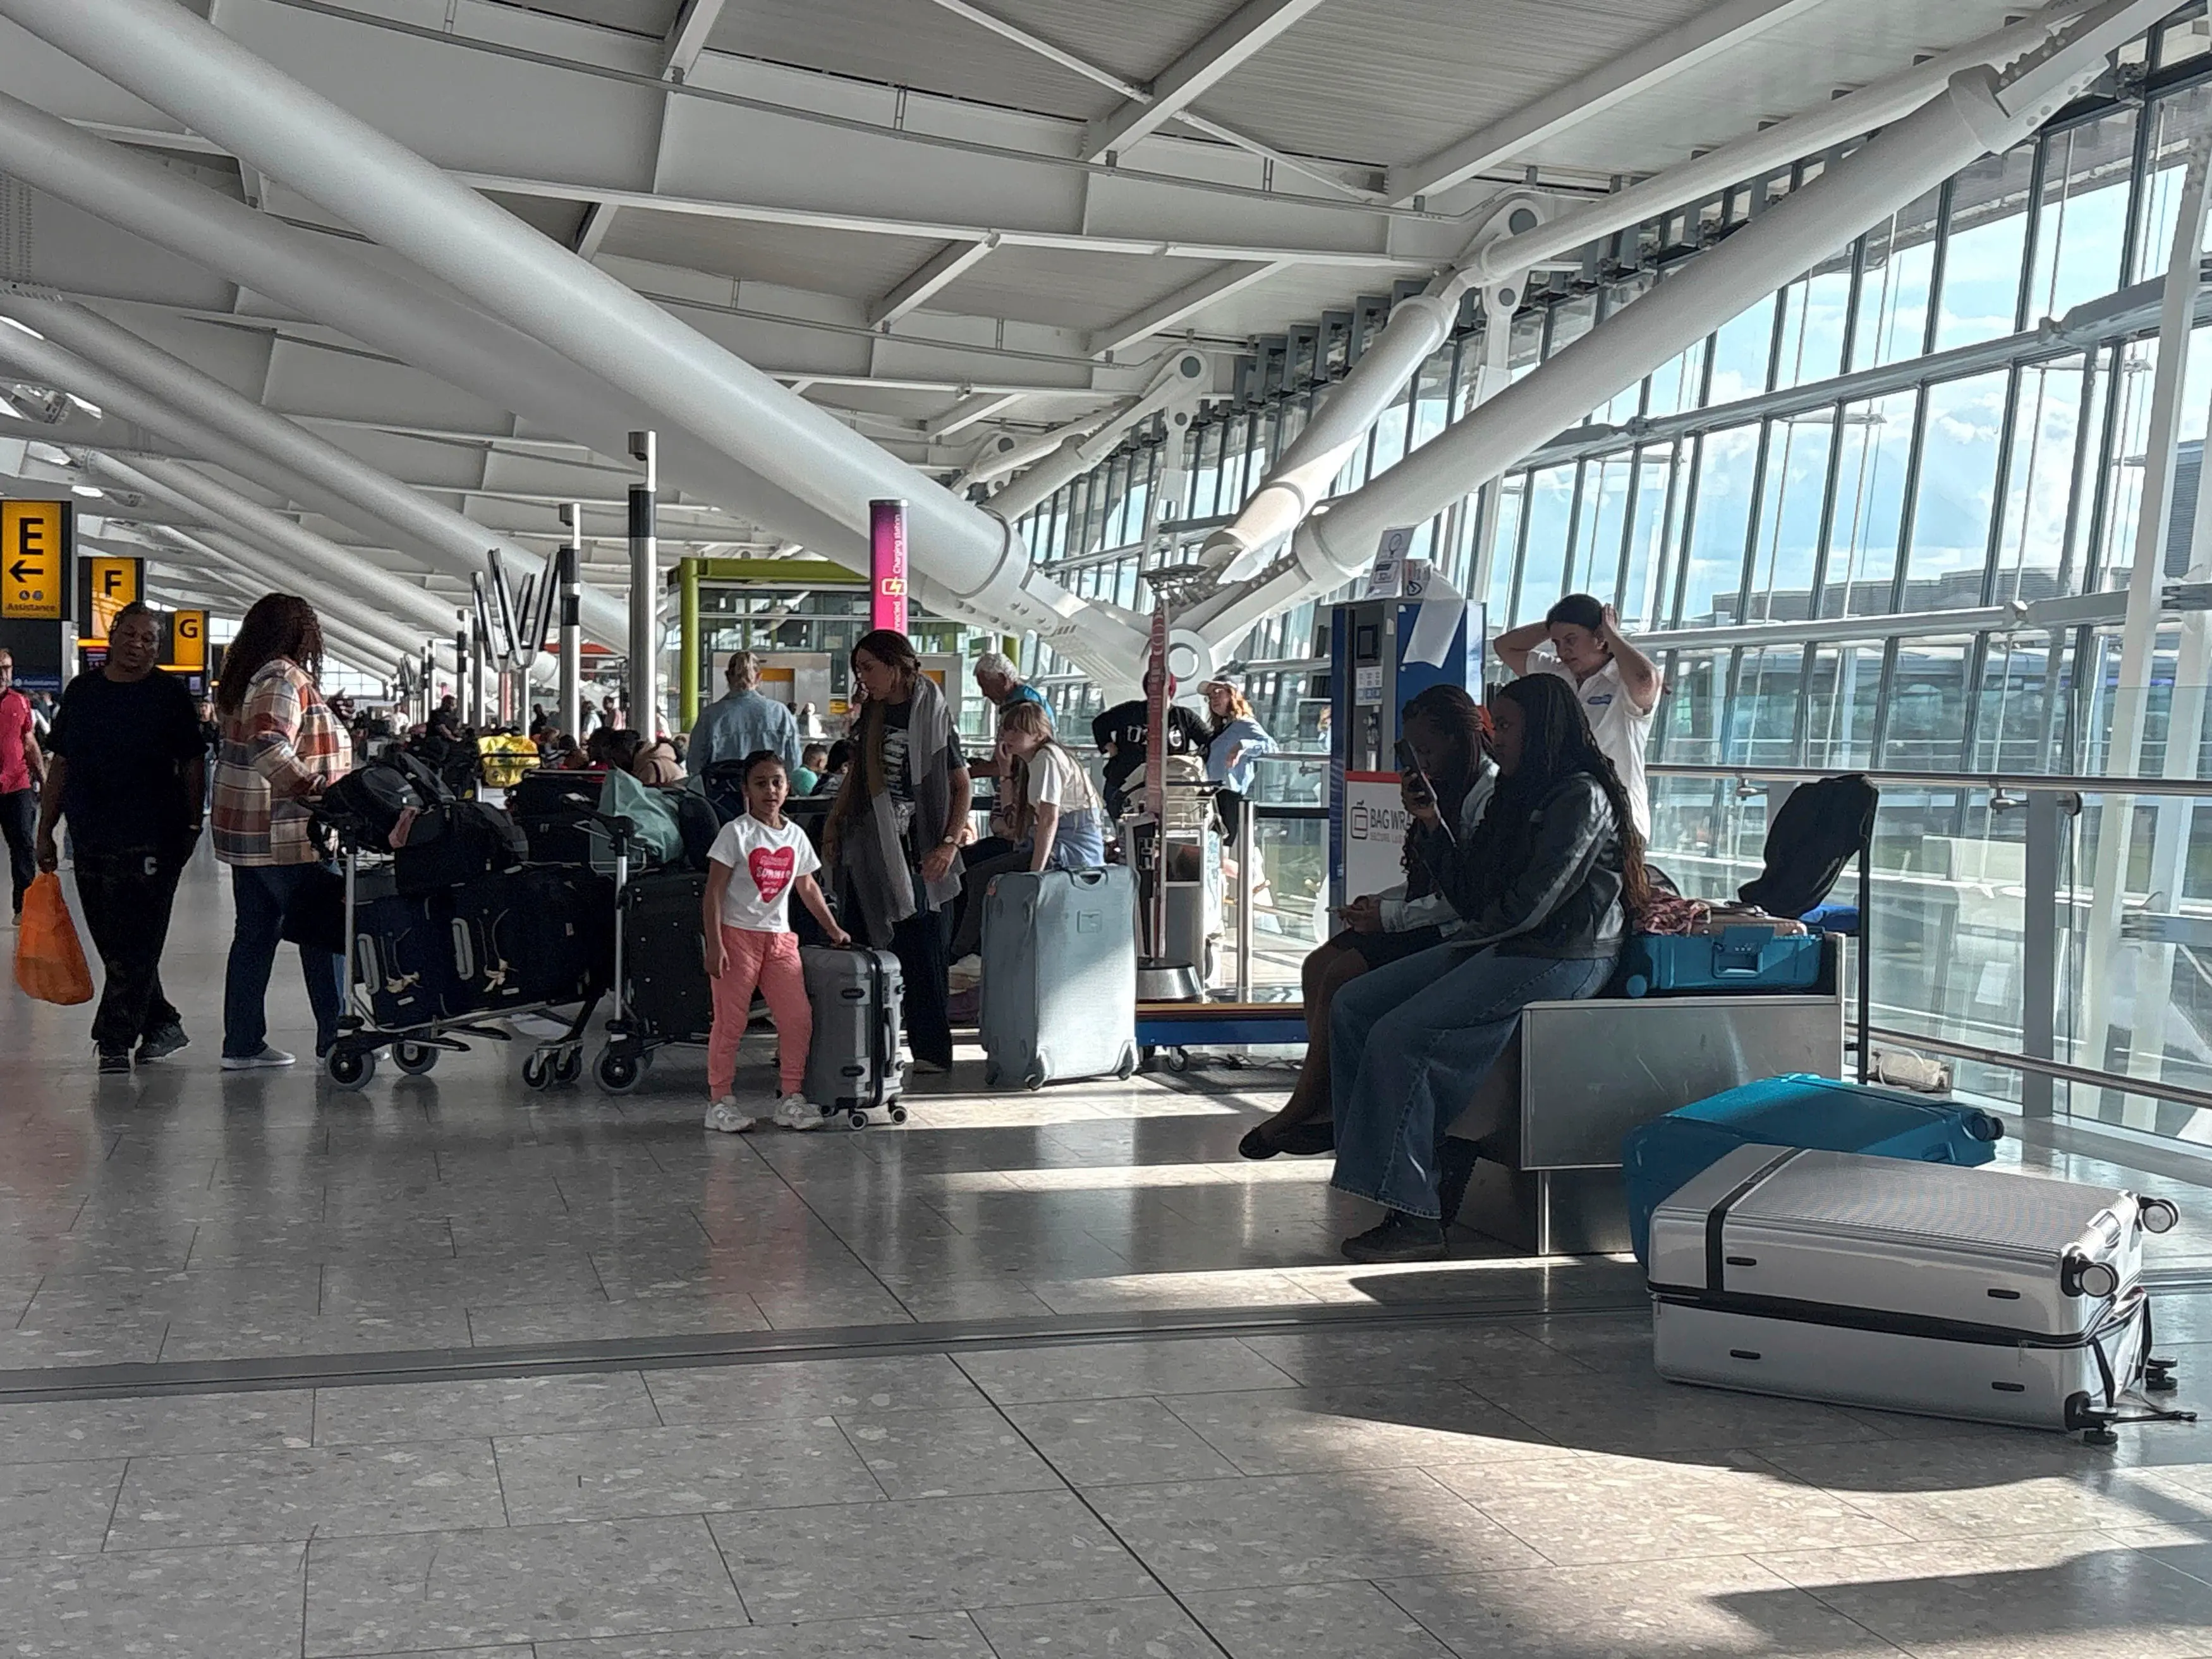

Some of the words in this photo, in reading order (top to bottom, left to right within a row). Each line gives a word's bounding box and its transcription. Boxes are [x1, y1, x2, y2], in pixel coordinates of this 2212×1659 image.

[19, 518, 44, 556] E
[892, 540, 902, 574] Charging
[104, 570, 122, 597] F
[6, 602, 56, 611] Assistance
[179, 619, 198, 638] G
[1370, 808, 1390, 829] BAG
[1390, 810, 1413, 830] WRA
